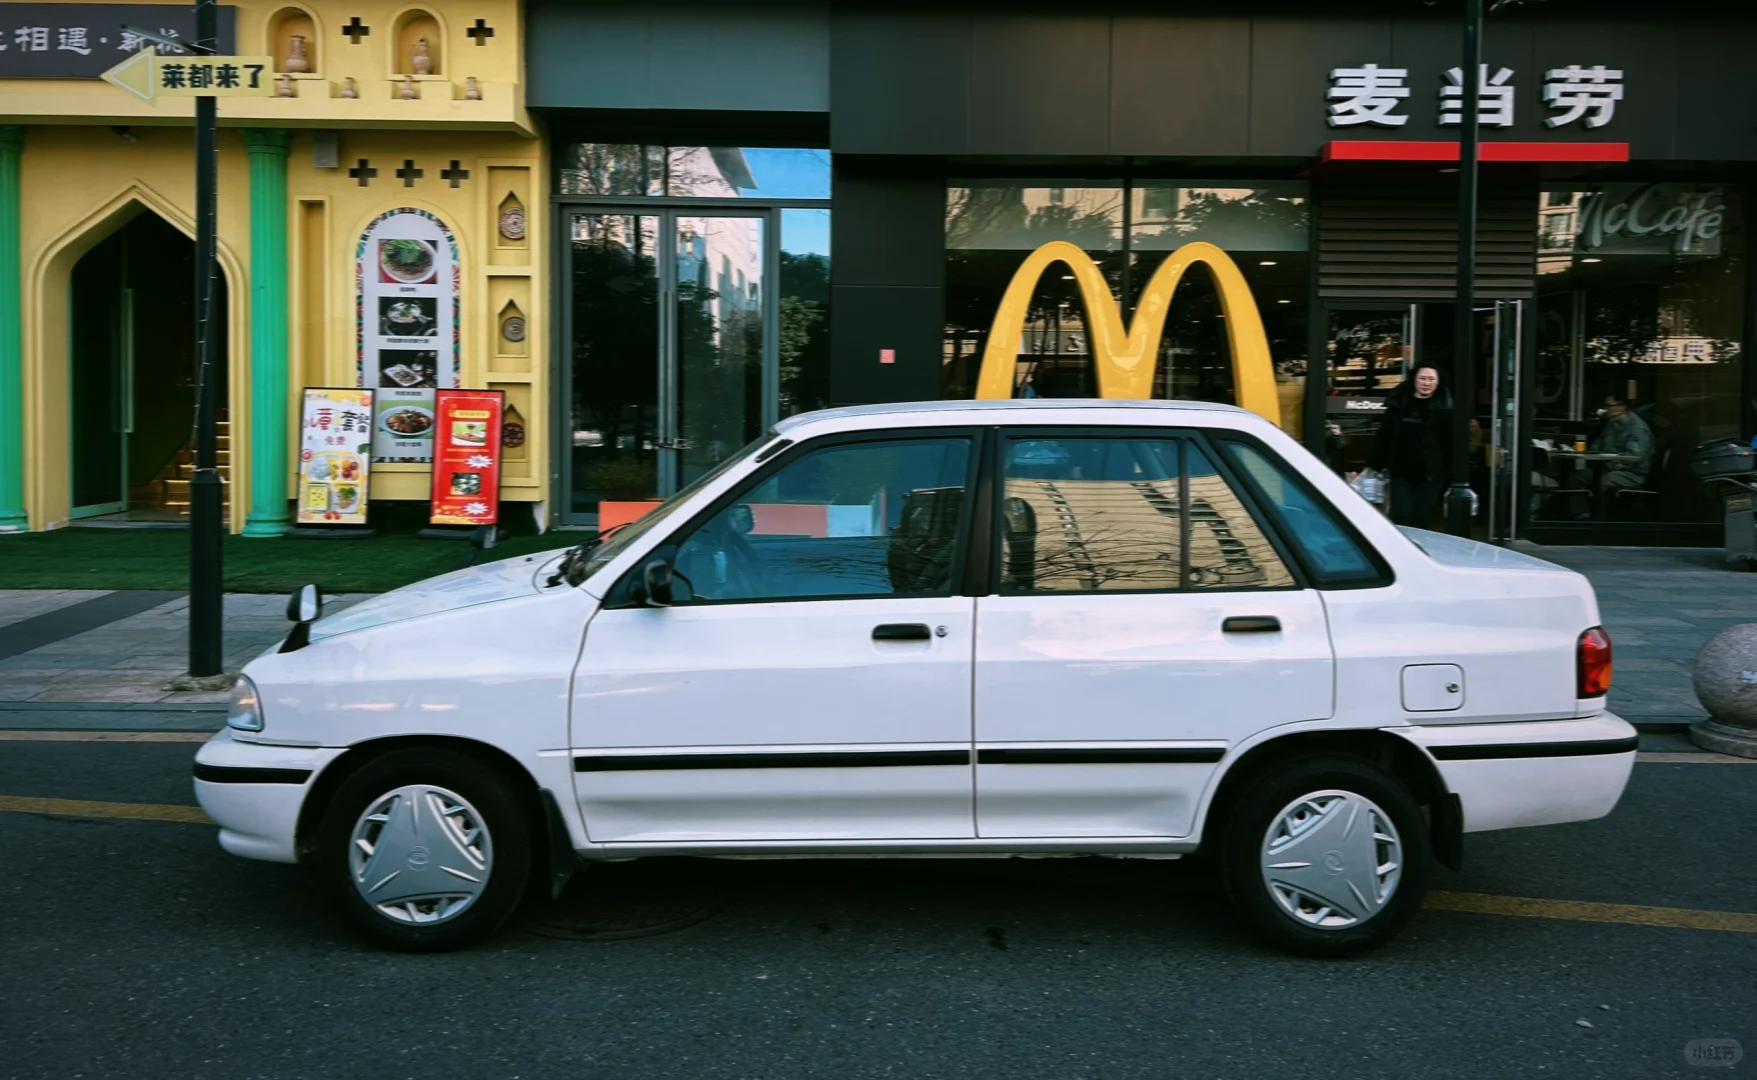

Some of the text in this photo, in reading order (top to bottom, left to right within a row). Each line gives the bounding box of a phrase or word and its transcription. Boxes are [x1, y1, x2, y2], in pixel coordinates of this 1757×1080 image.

[161, 64, 266, 89] 莱都来了
[1327, 63, 1624, 129] 麦当劳
[1577, 182, 1726, 252] McCafé
